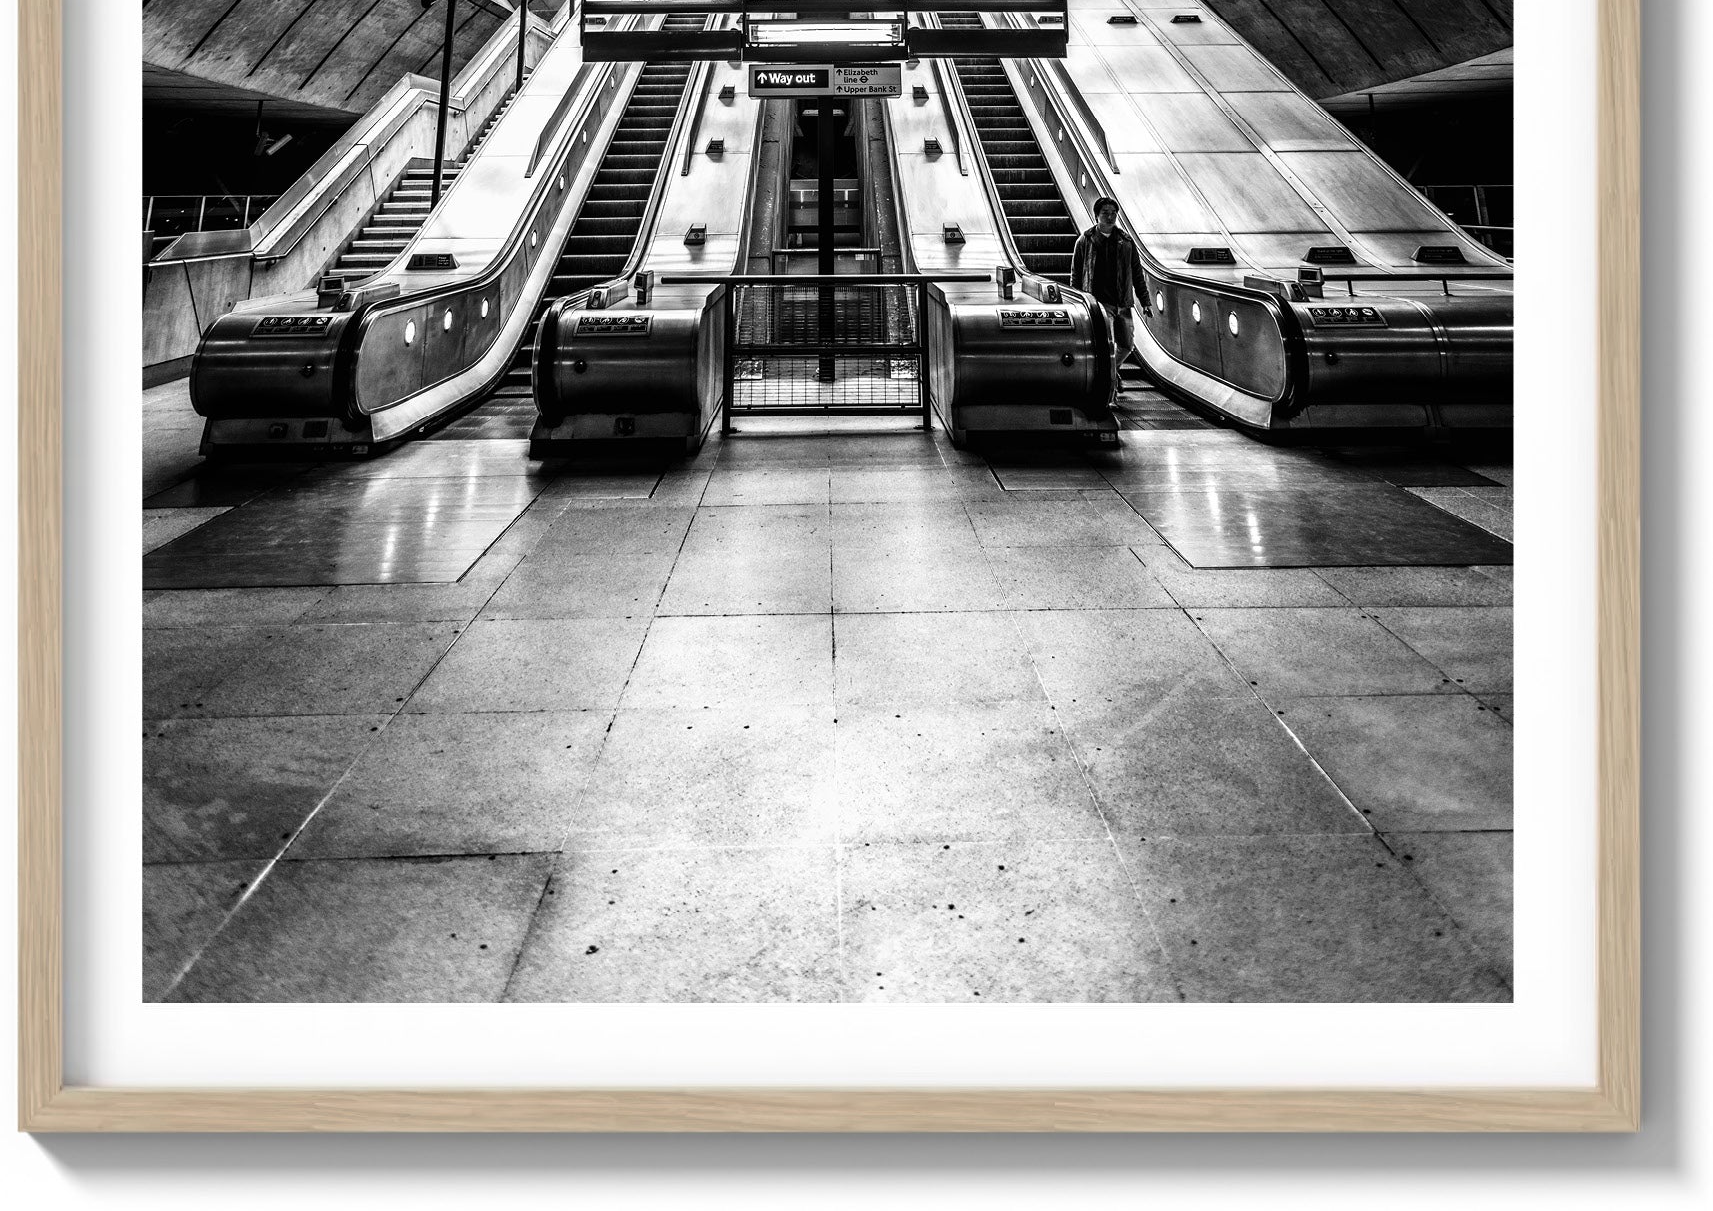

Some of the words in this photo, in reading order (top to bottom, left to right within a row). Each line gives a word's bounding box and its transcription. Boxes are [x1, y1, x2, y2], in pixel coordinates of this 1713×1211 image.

[769, 72, 793, 85] Way
[795, 73, 816, 83] out
[843, 86, 867, 94] Upper
